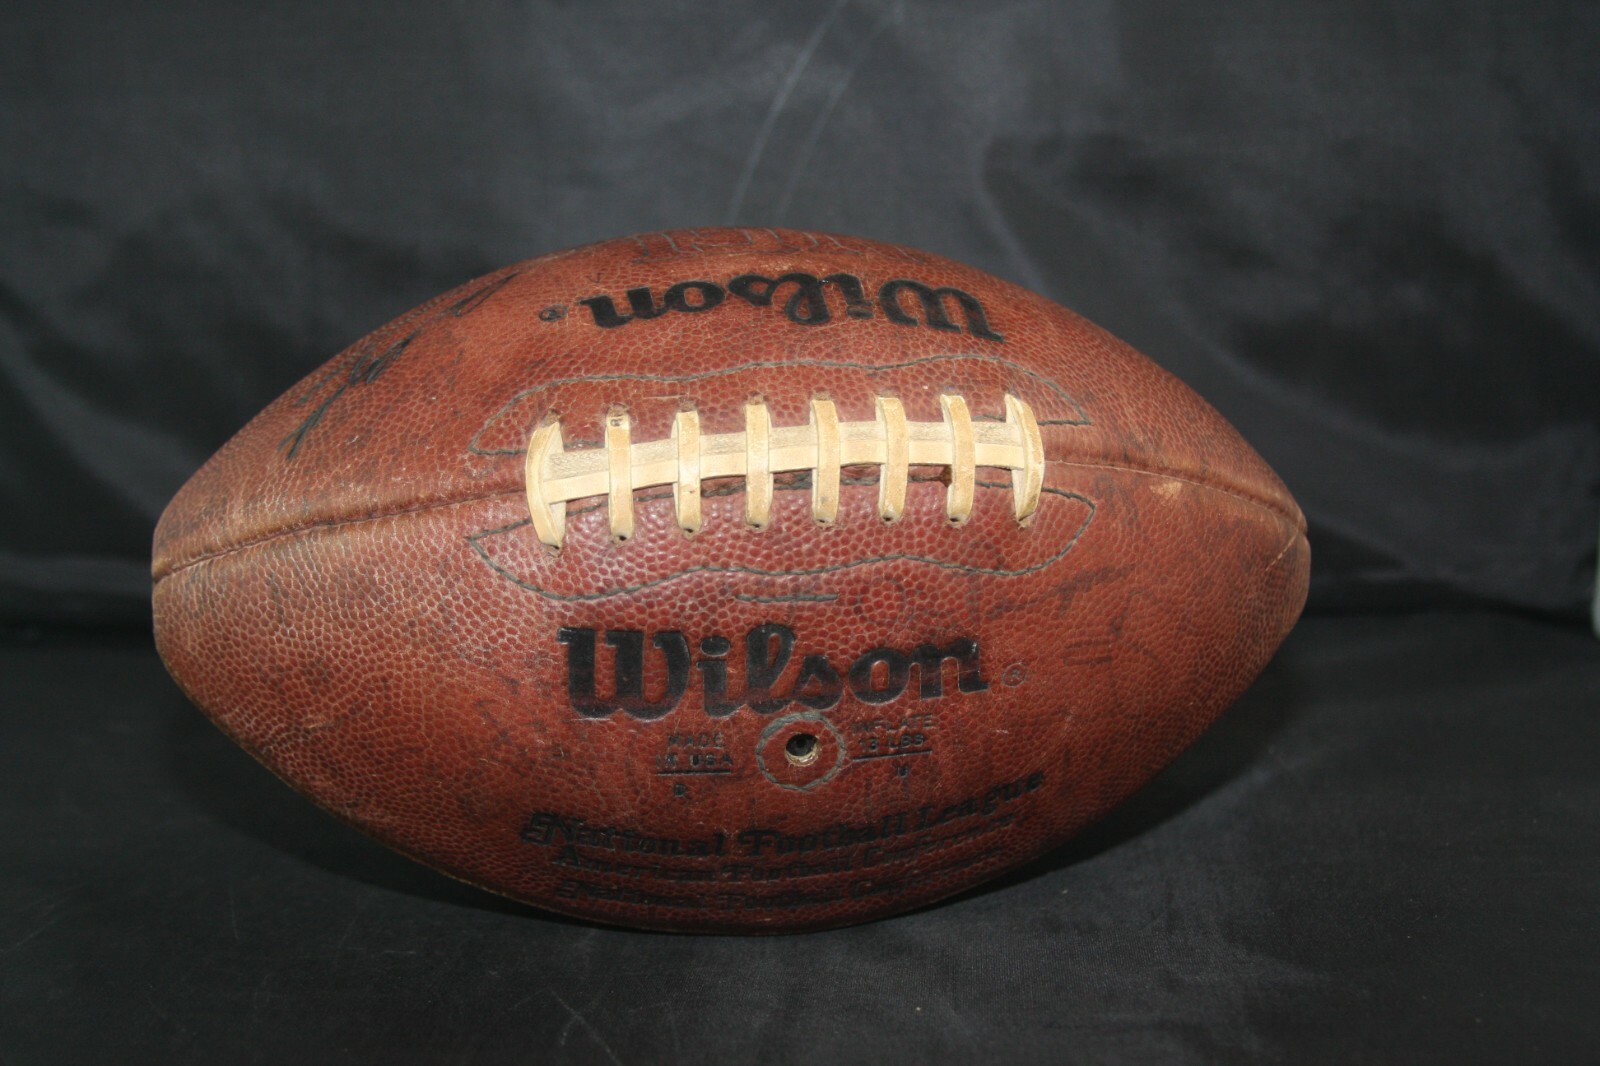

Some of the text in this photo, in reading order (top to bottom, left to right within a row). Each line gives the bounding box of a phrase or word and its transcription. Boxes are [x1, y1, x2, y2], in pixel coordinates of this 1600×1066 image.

[579, 272, 1005, 343] Wilson
[556, 622, 990, 721] Wilson
[666, 731, 727, 751] MADE
[851, 714, 935, 736] INFLATE
[688, 752, 734, 768] USA
[736, 812, 908, 857] Football
[915, 771, 1045, 829] League
